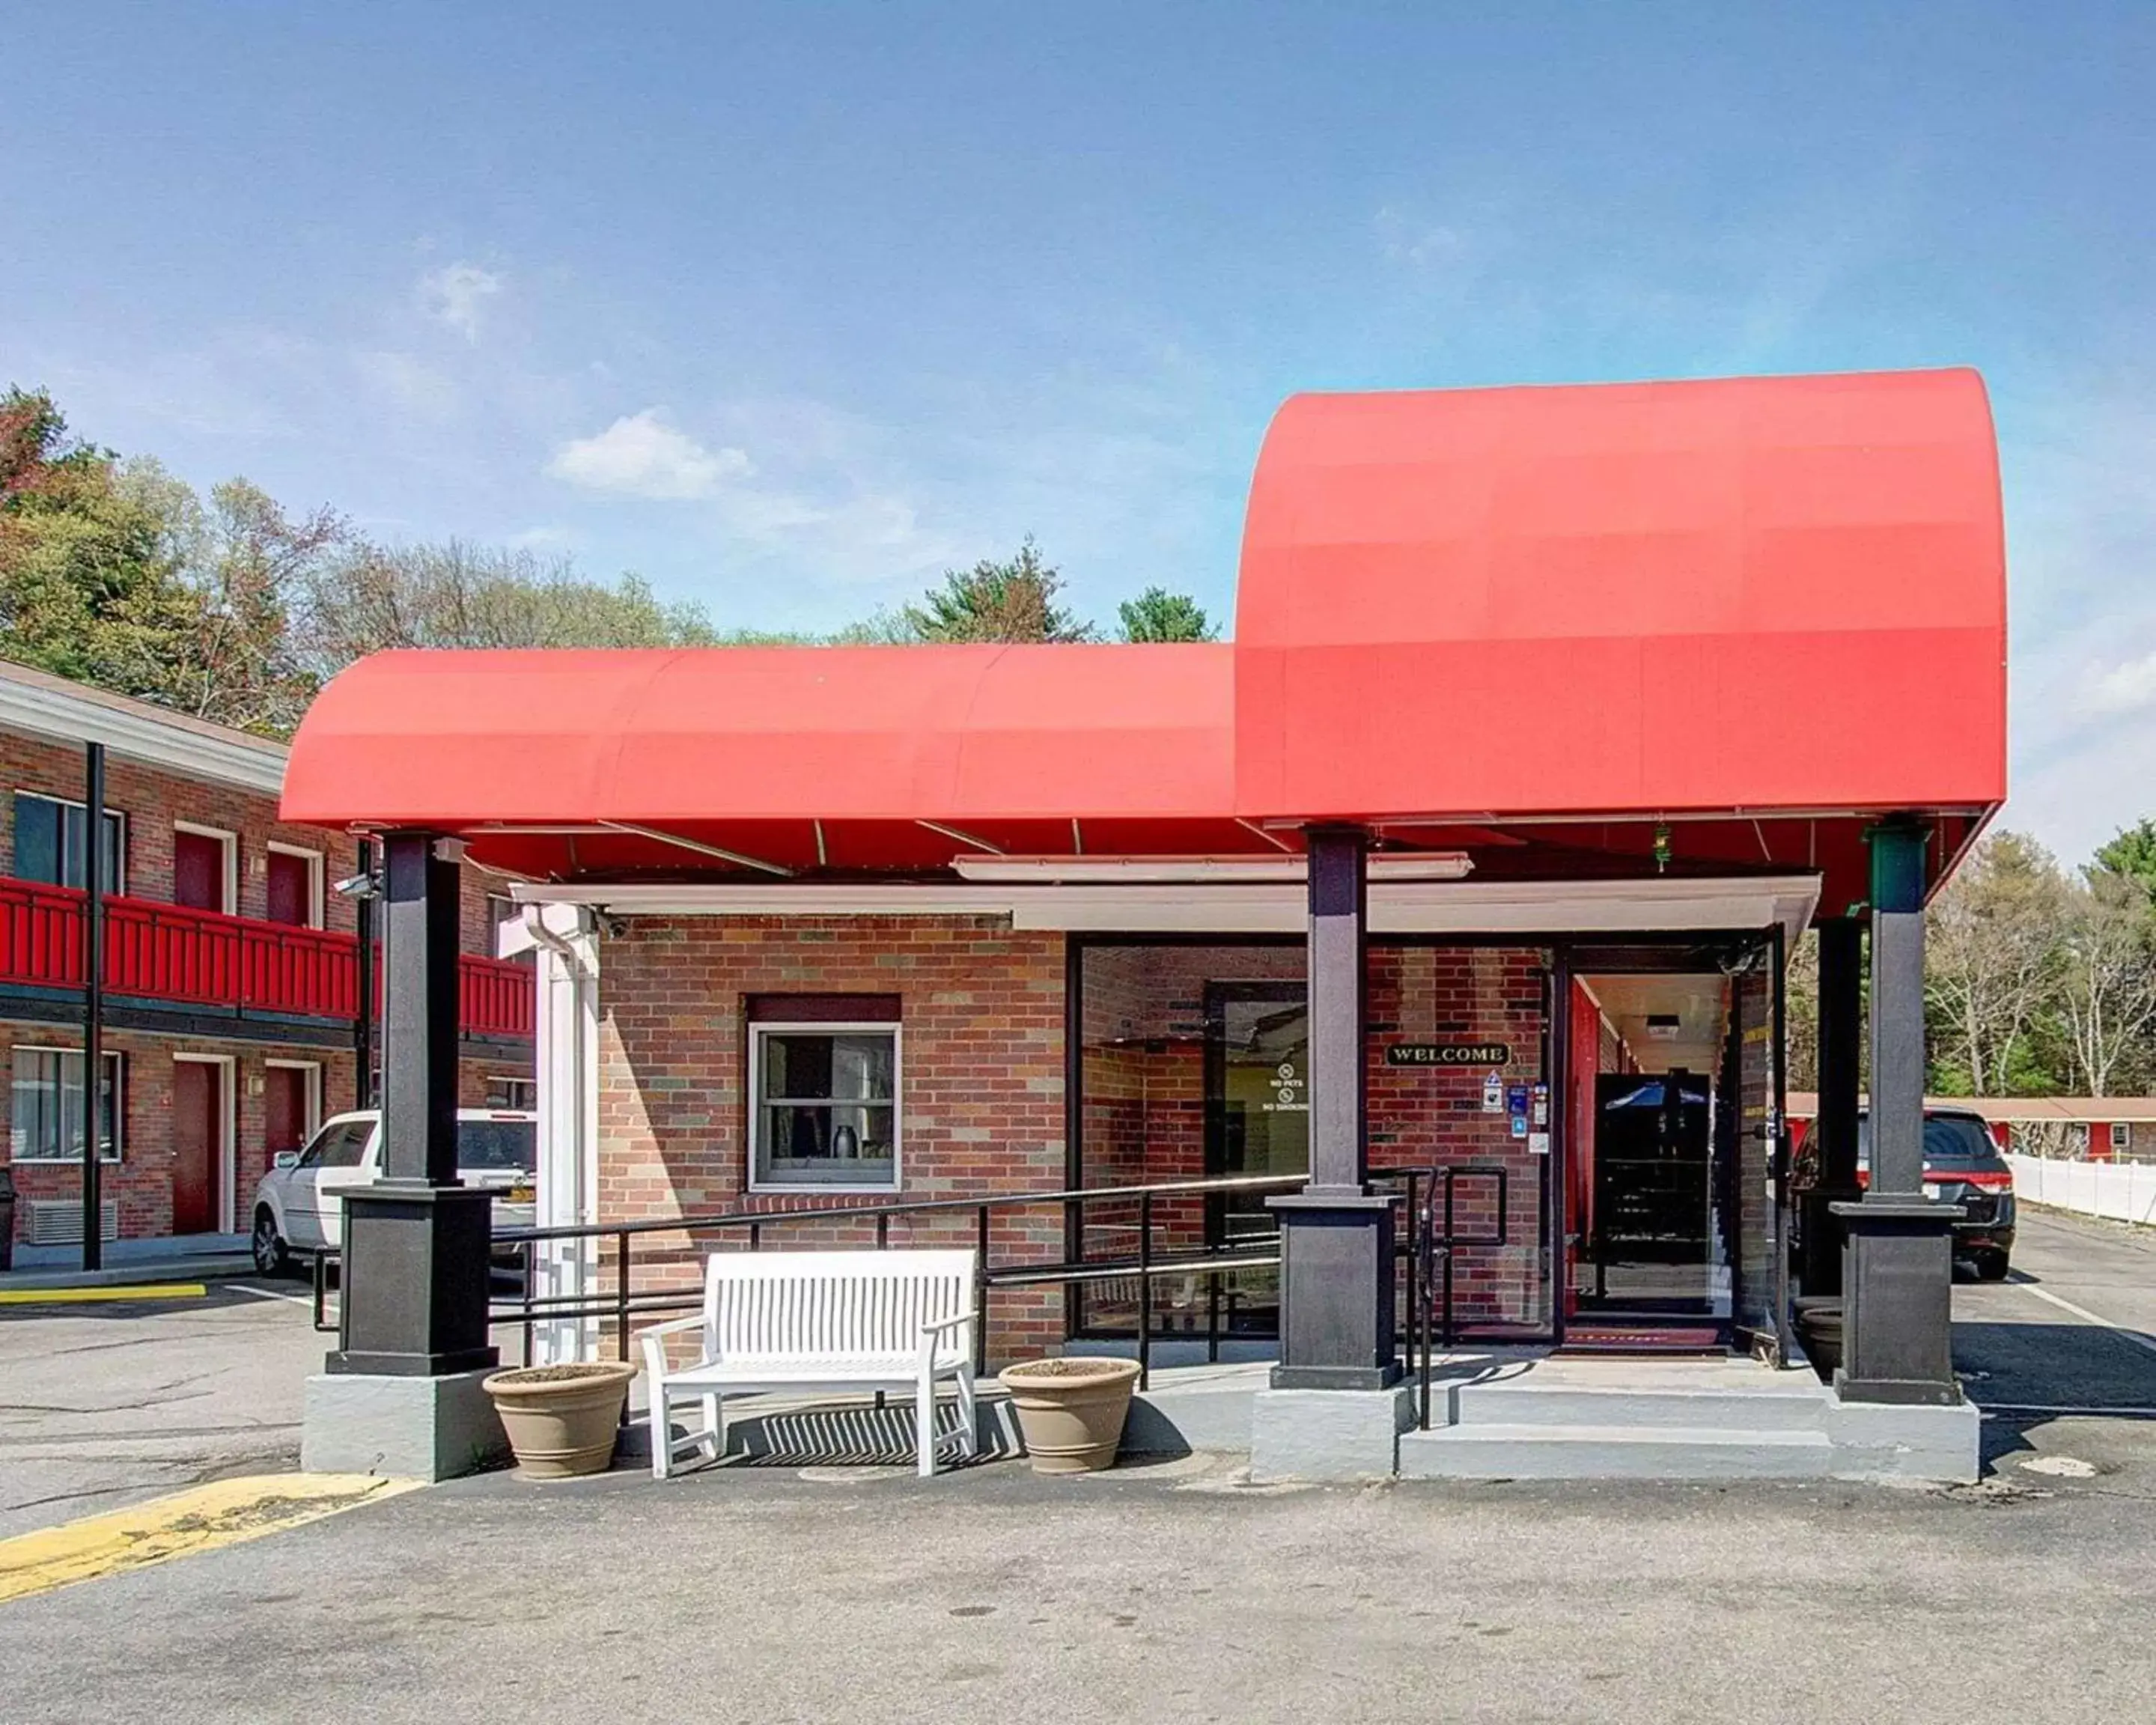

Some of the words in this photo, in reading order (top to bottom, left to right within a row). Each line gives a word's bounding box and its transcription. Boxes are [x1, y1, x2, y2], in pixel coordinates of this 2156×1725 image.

[1393, 1047, 1504, 1062] WELCOME
[1270, 1080, 1282, 1088] NO
[1262, 1103, 1274, 1111] NO
